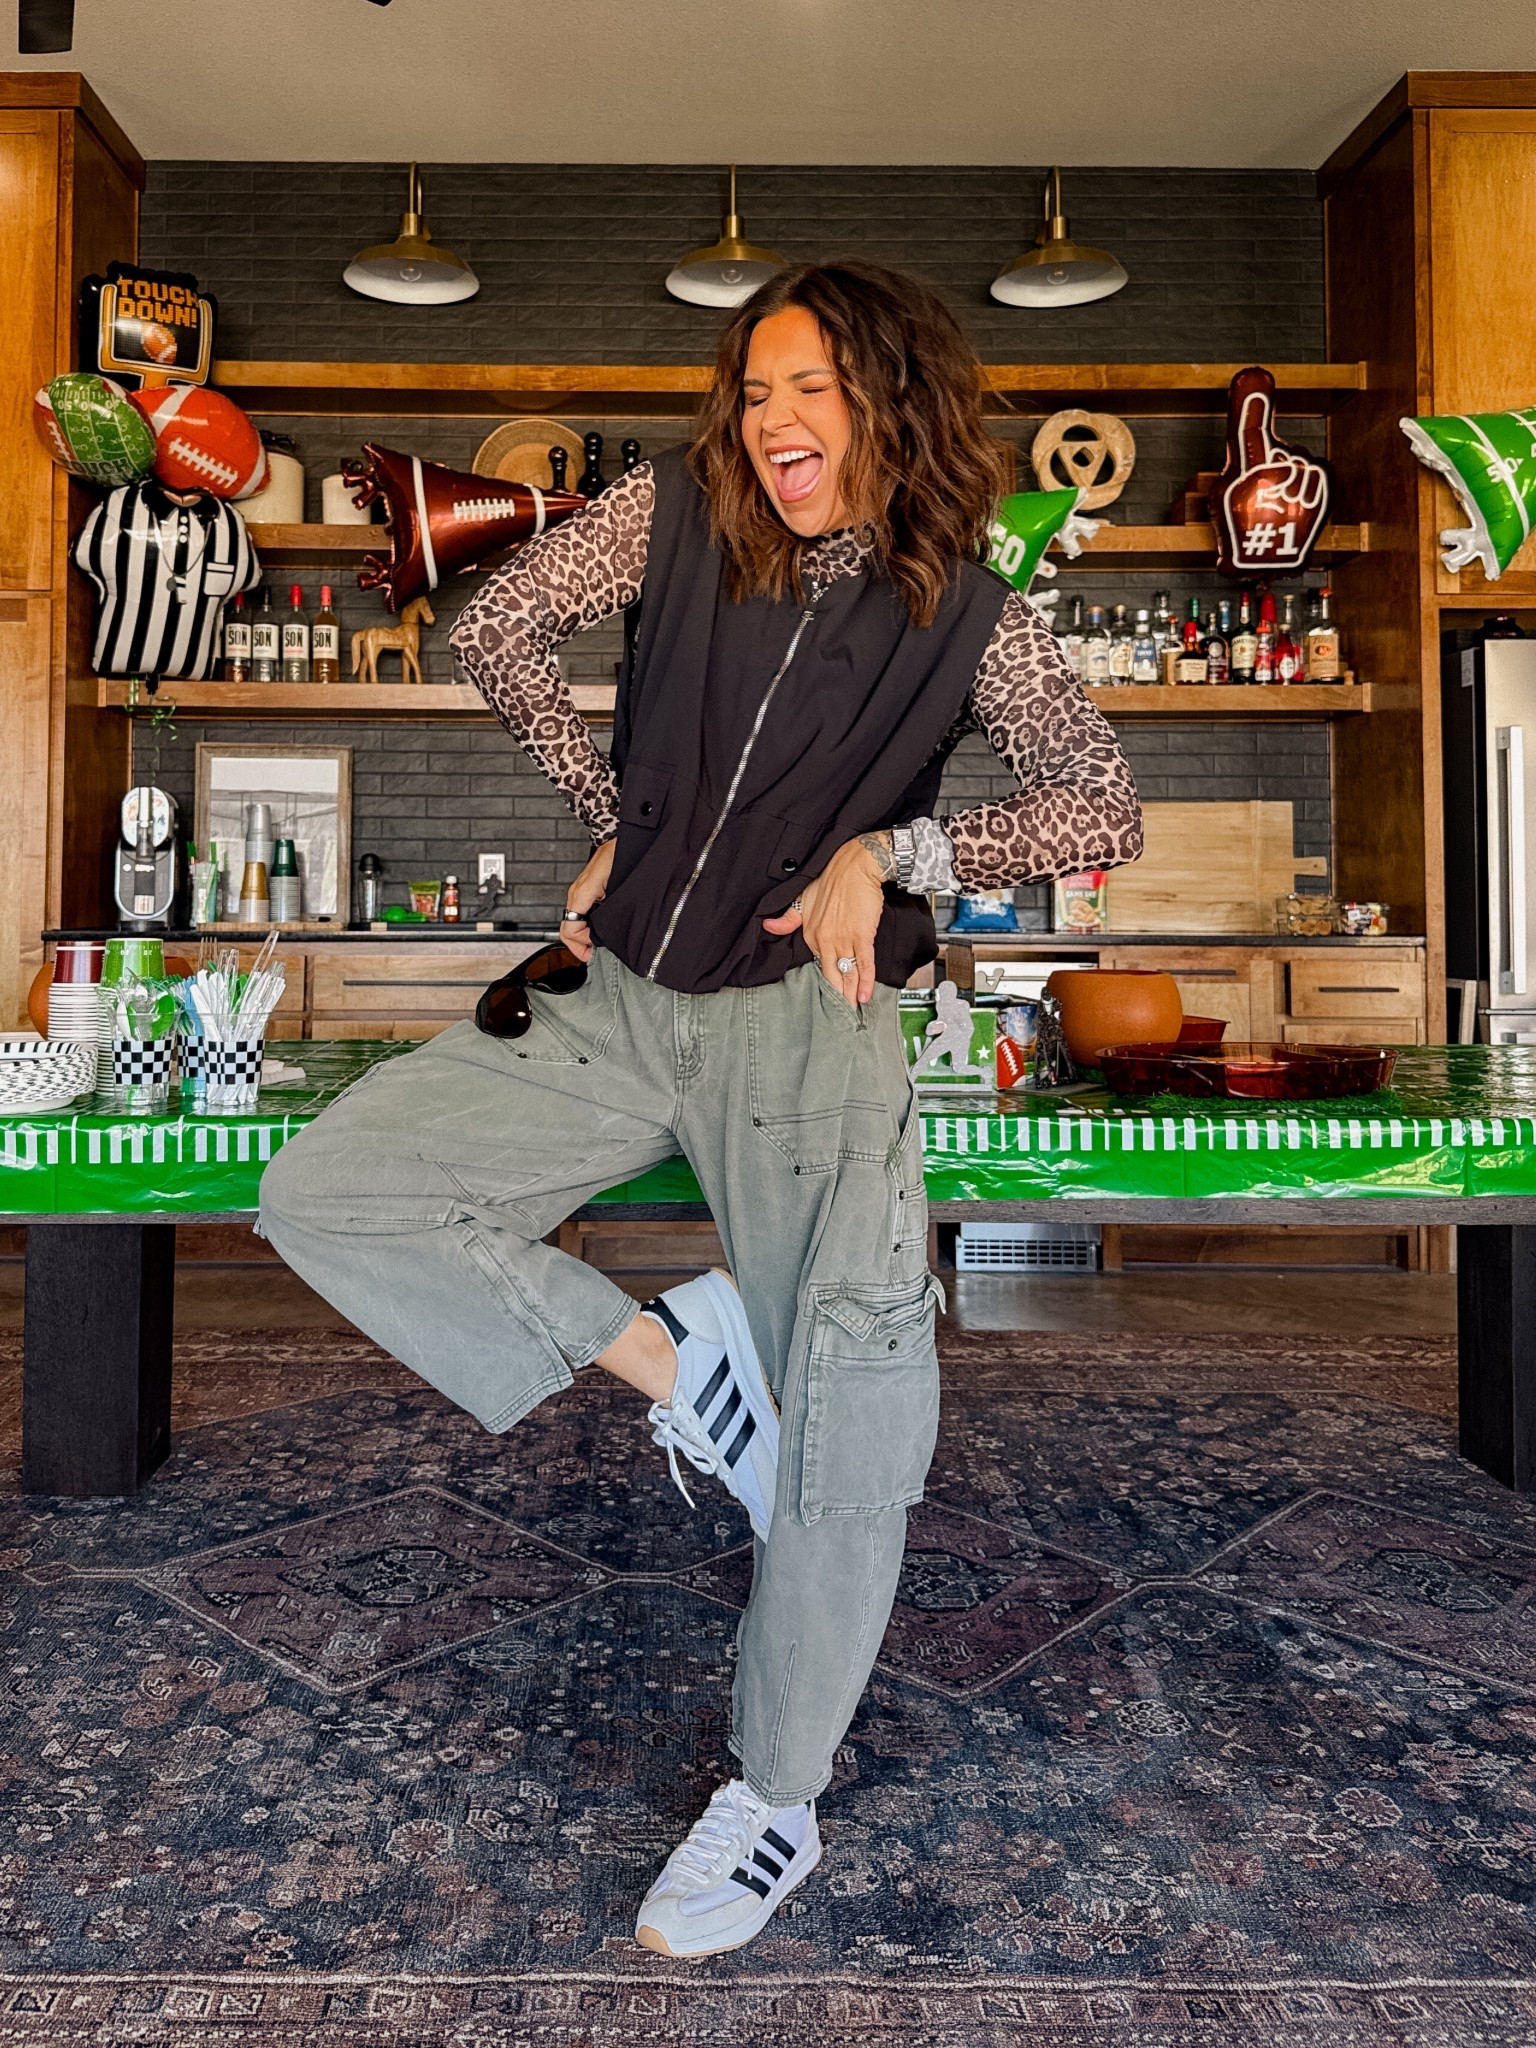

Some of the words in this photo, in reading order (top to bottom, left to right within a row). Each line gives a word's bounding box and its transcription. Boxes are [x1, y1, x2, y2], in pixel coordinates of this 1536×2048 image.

[116, 279, 199, 306] TOUCH
[118, 297, 197, 328] DOWN!
[1486, 457, 1519, 483] 50
[1242, 521, 1299, 556] #1
[228, 630, 248, 646] SON
[254, 630, 272, 647] SON
[285, 631, 303, 648] SON
[314, 631, 332, 648] SON
